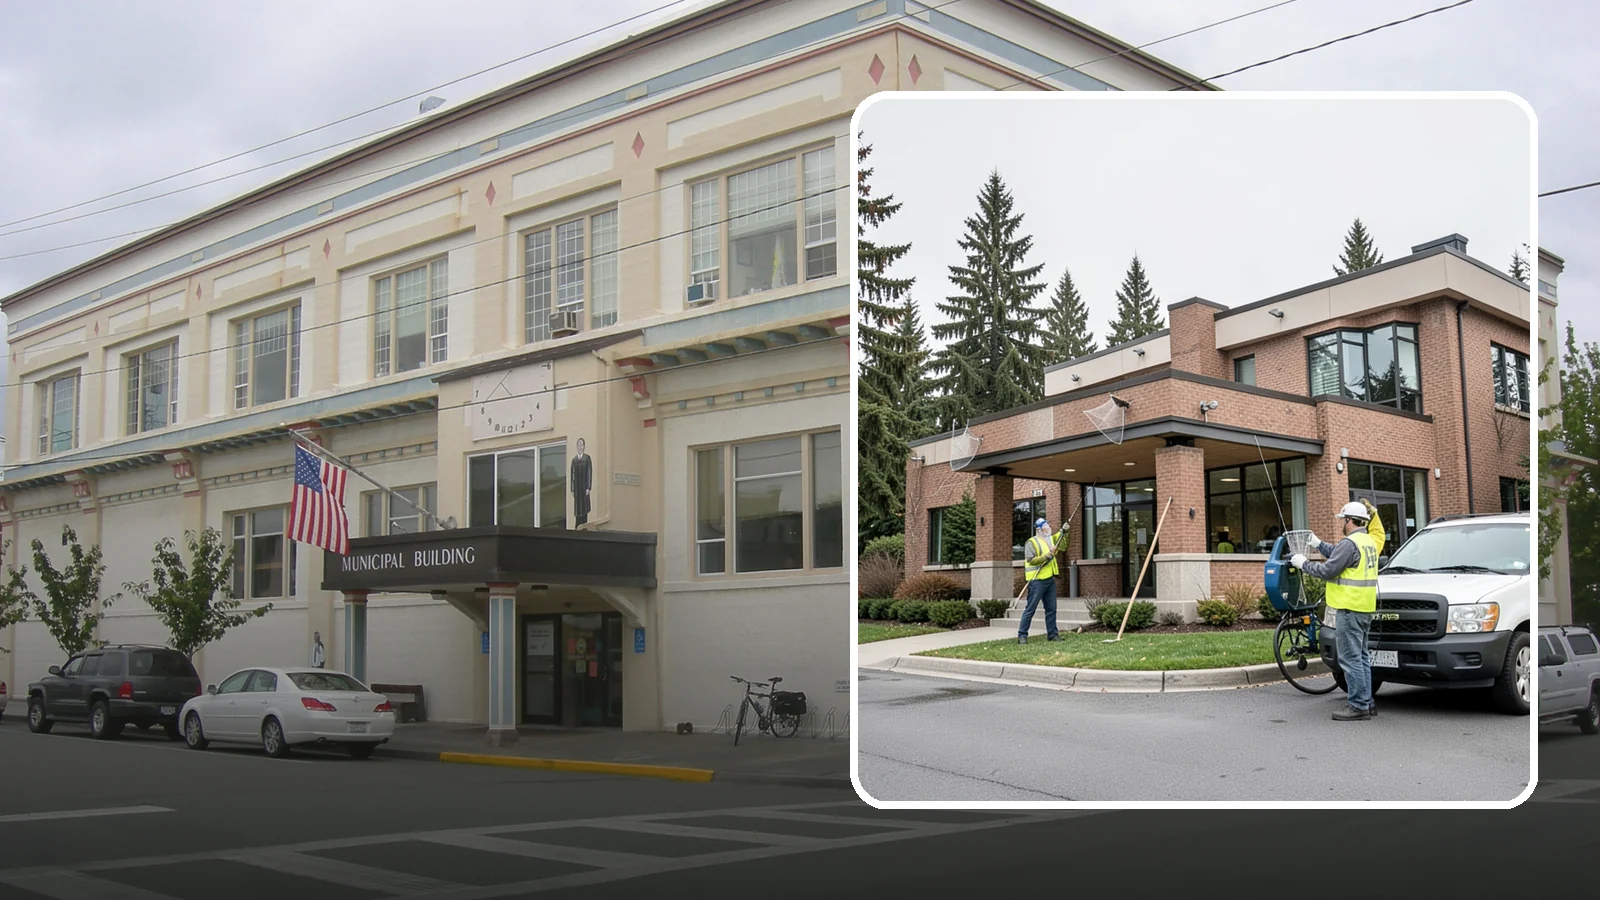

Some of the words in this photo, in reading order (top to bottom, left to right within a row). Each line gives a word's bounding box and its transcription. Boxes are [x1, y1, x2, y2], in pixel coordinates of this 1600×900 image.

[536, 402, 540, 410] 4
[480, 407, 485, 415] 8
[487, 417, 492, 425] 9
[529, 414, 533, 422] 3
[494, 423, 500, 432] 10
[521, 420, 525, 428] 2
[342, 552, 405, 572] MUNICIPAL
[414, 546, 475, 567] BUILDING
